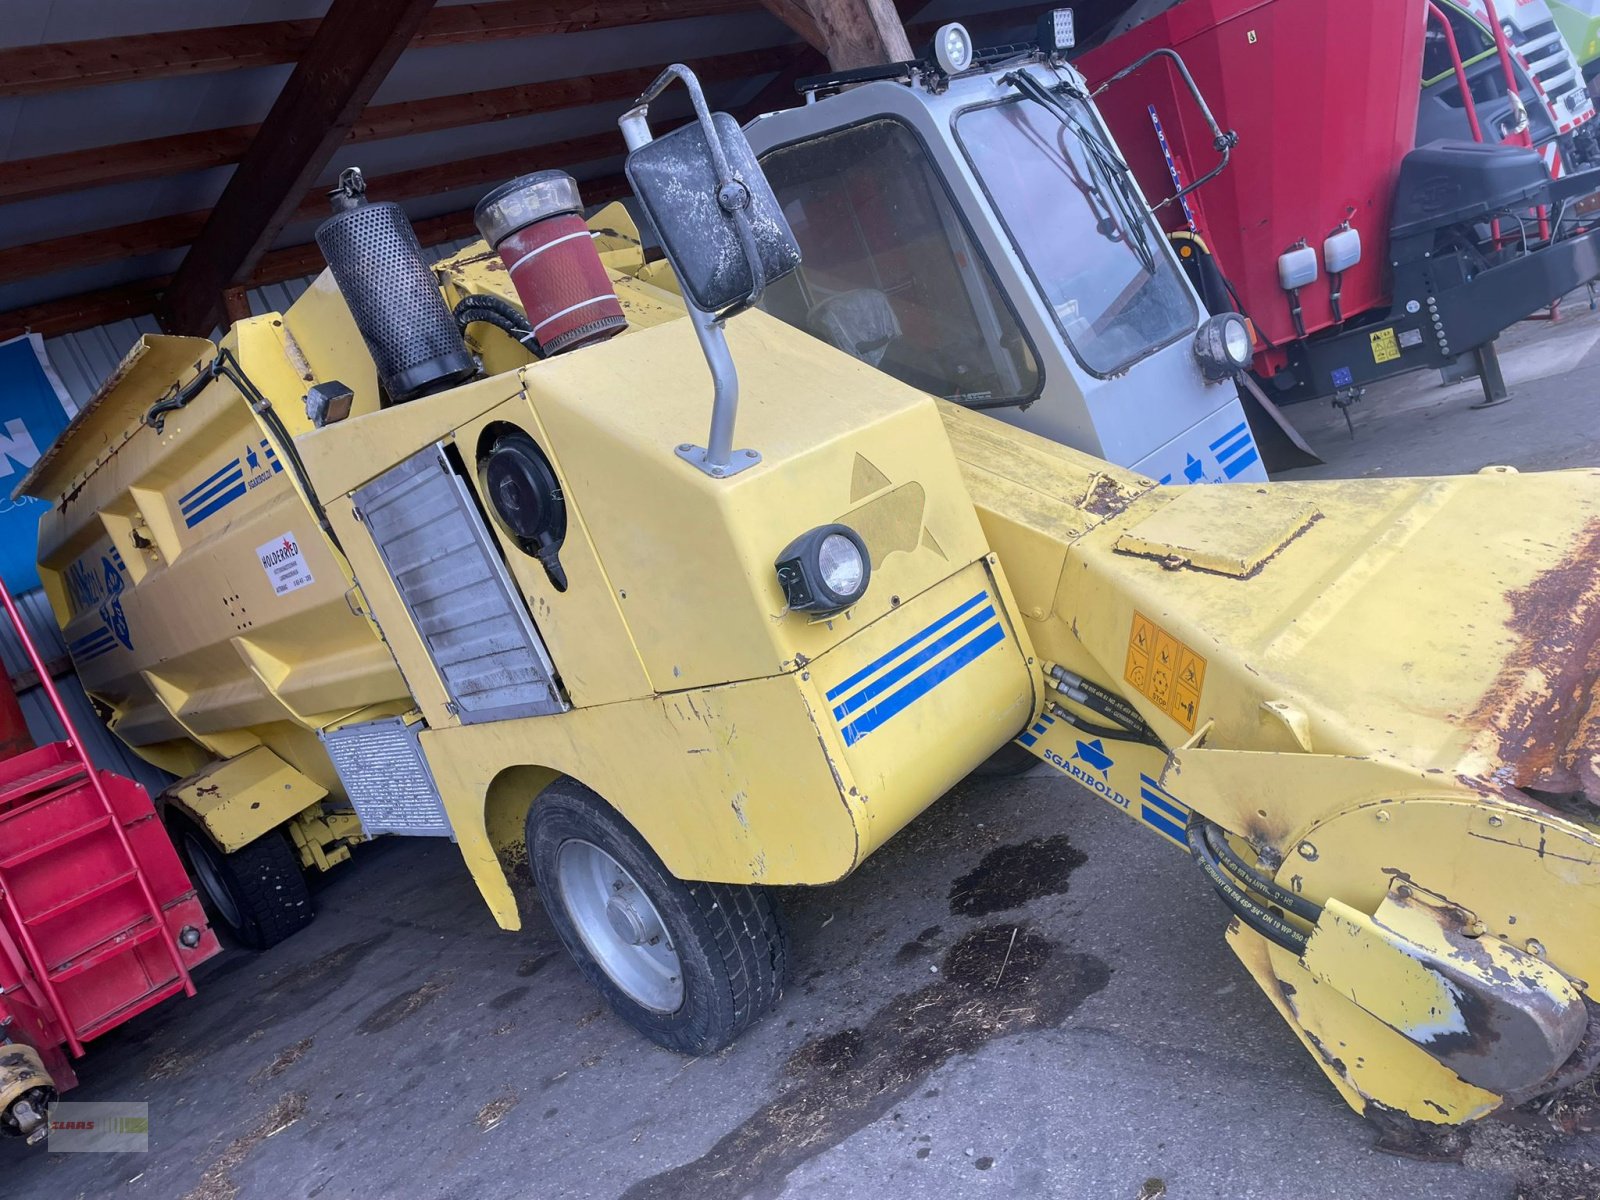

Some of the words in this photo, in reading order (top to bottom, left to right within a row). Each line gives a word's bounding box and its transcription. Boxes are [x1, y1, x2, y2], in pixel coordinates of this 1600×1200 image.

[1043, 748, 1131, 809] SGARIBOLDI
[1204, 864, 1226, 887] GERMANY
[1223, 884, 1233, 894] EN
[1239, 898, 1252, 909] 4SP
[1262, 913, 1274, 924] DN
[1280, 923, 1293, 935] WP
